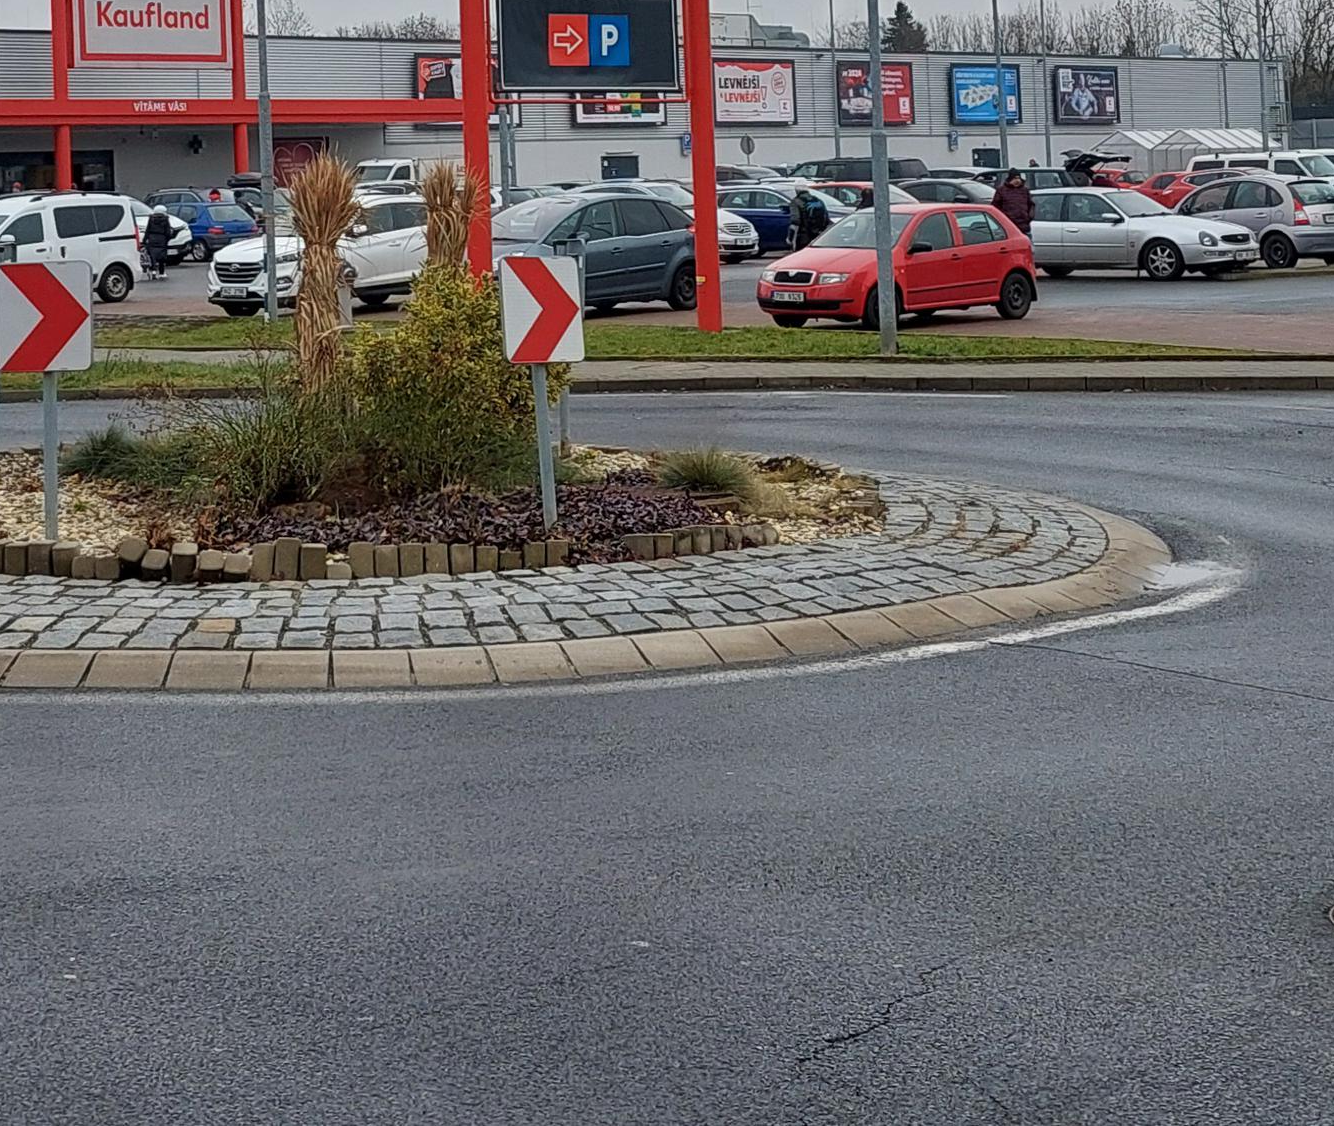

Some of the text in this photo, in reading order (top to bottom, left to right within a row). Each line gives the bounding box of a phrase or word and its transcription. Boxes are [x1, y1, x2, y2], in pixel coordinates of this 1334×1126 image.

[95, 0, 210, 31] Kaufland
[600, 24, 620, 57] P
[133, 100, 188, 112] VÍTÁME VÁS!
